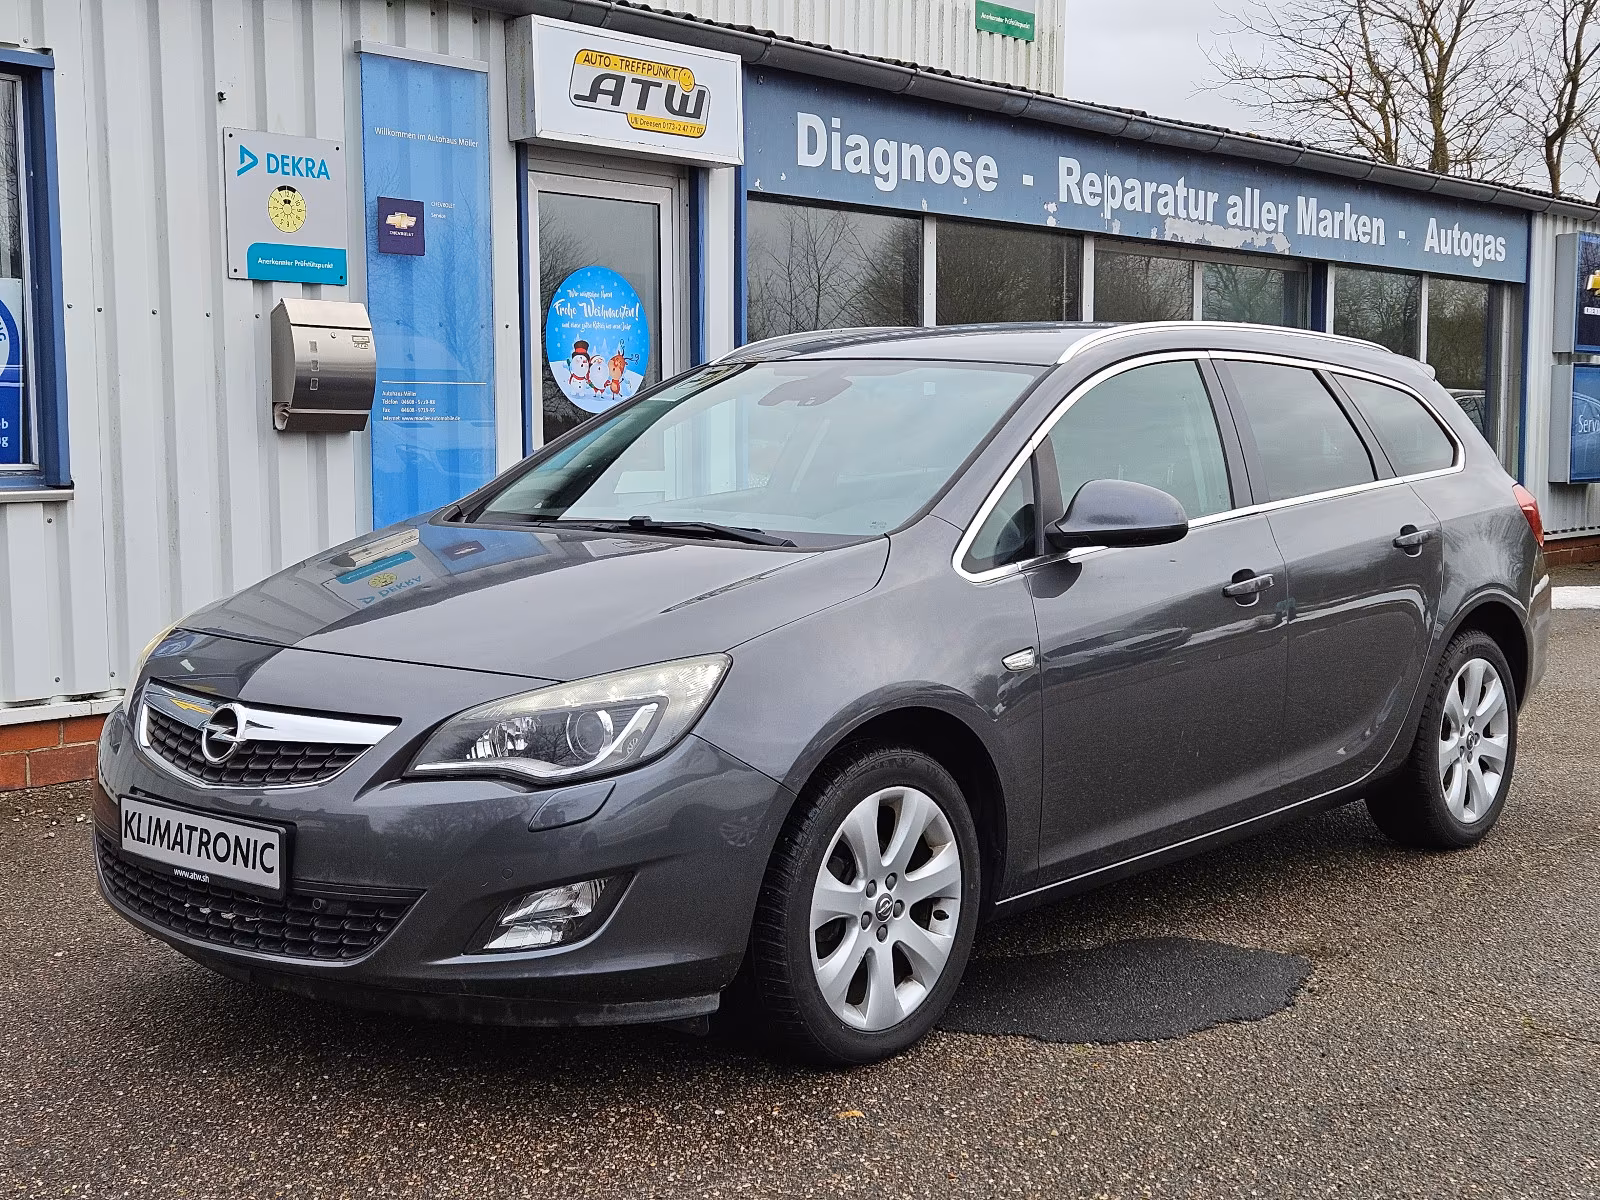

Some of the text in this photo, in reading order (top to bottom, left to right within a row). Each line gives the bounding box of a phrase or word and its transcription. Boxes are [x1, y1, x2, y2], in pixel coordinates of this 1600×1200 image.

[583, 53, 611, 68] AUTO
[619, 58, 678, 80] TREFFPUNKT
[574, 73, 706, 120] ATW
[374, 126, 479, 148] Willkommen im Autohaus Möller
[266, 152, 331, 181] DEKRA
[797, 112, 999, 192] Diagnose
[1058, 156, 1219, 222] Reparatur
[1226, 187, 1289, 234] aller
[1297, 195, 1386, 246] Marken
[1424, 217, 1506, 267] Autogas
[257, 257, 293, 266] Anerkannter
[553, 298, 640, 322] Frohe Weihnachten!
[123, 809, 276, 874] KLIMATRONIC
[173, 867, 210, 884] www.atw.sh
